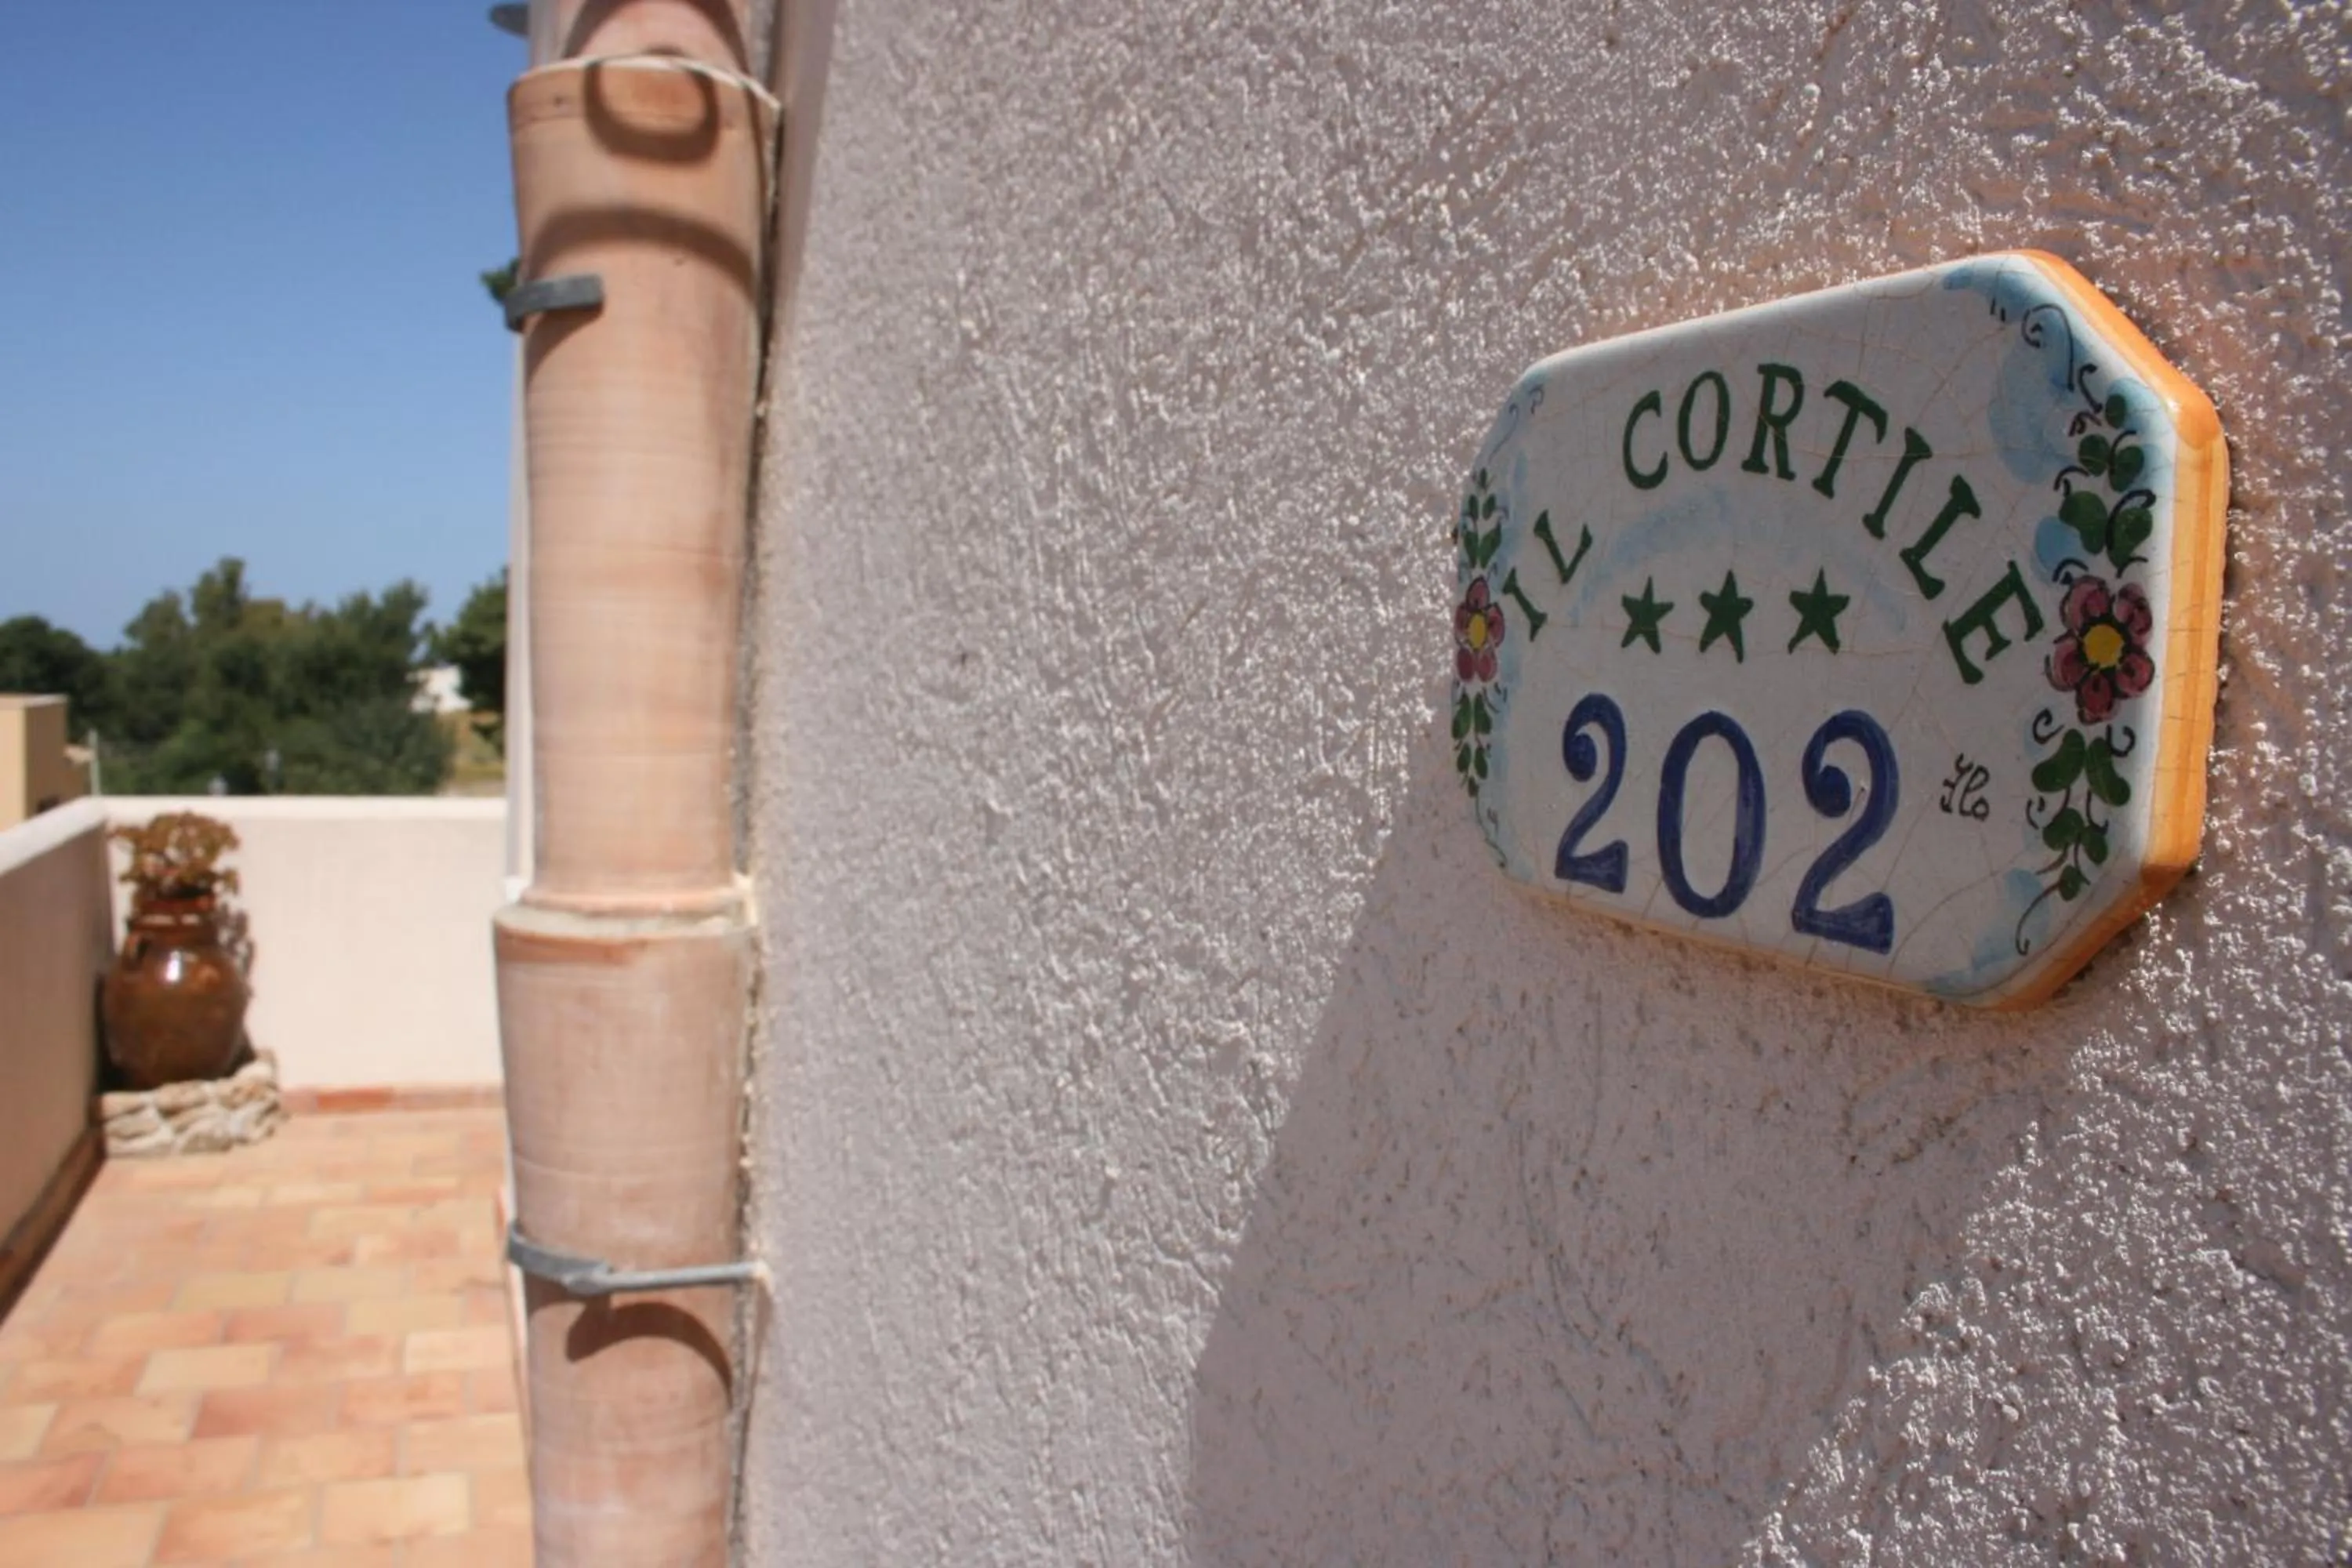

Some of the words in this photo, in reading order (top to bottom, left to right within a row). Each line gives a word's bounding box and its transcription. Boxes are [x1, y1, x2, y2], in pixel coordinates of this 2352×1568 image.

[1502, 510, 1592, 641] IL
[1622, 363, 2045, 684] CORTILE
[1555, 693, 1899, 954] 202
